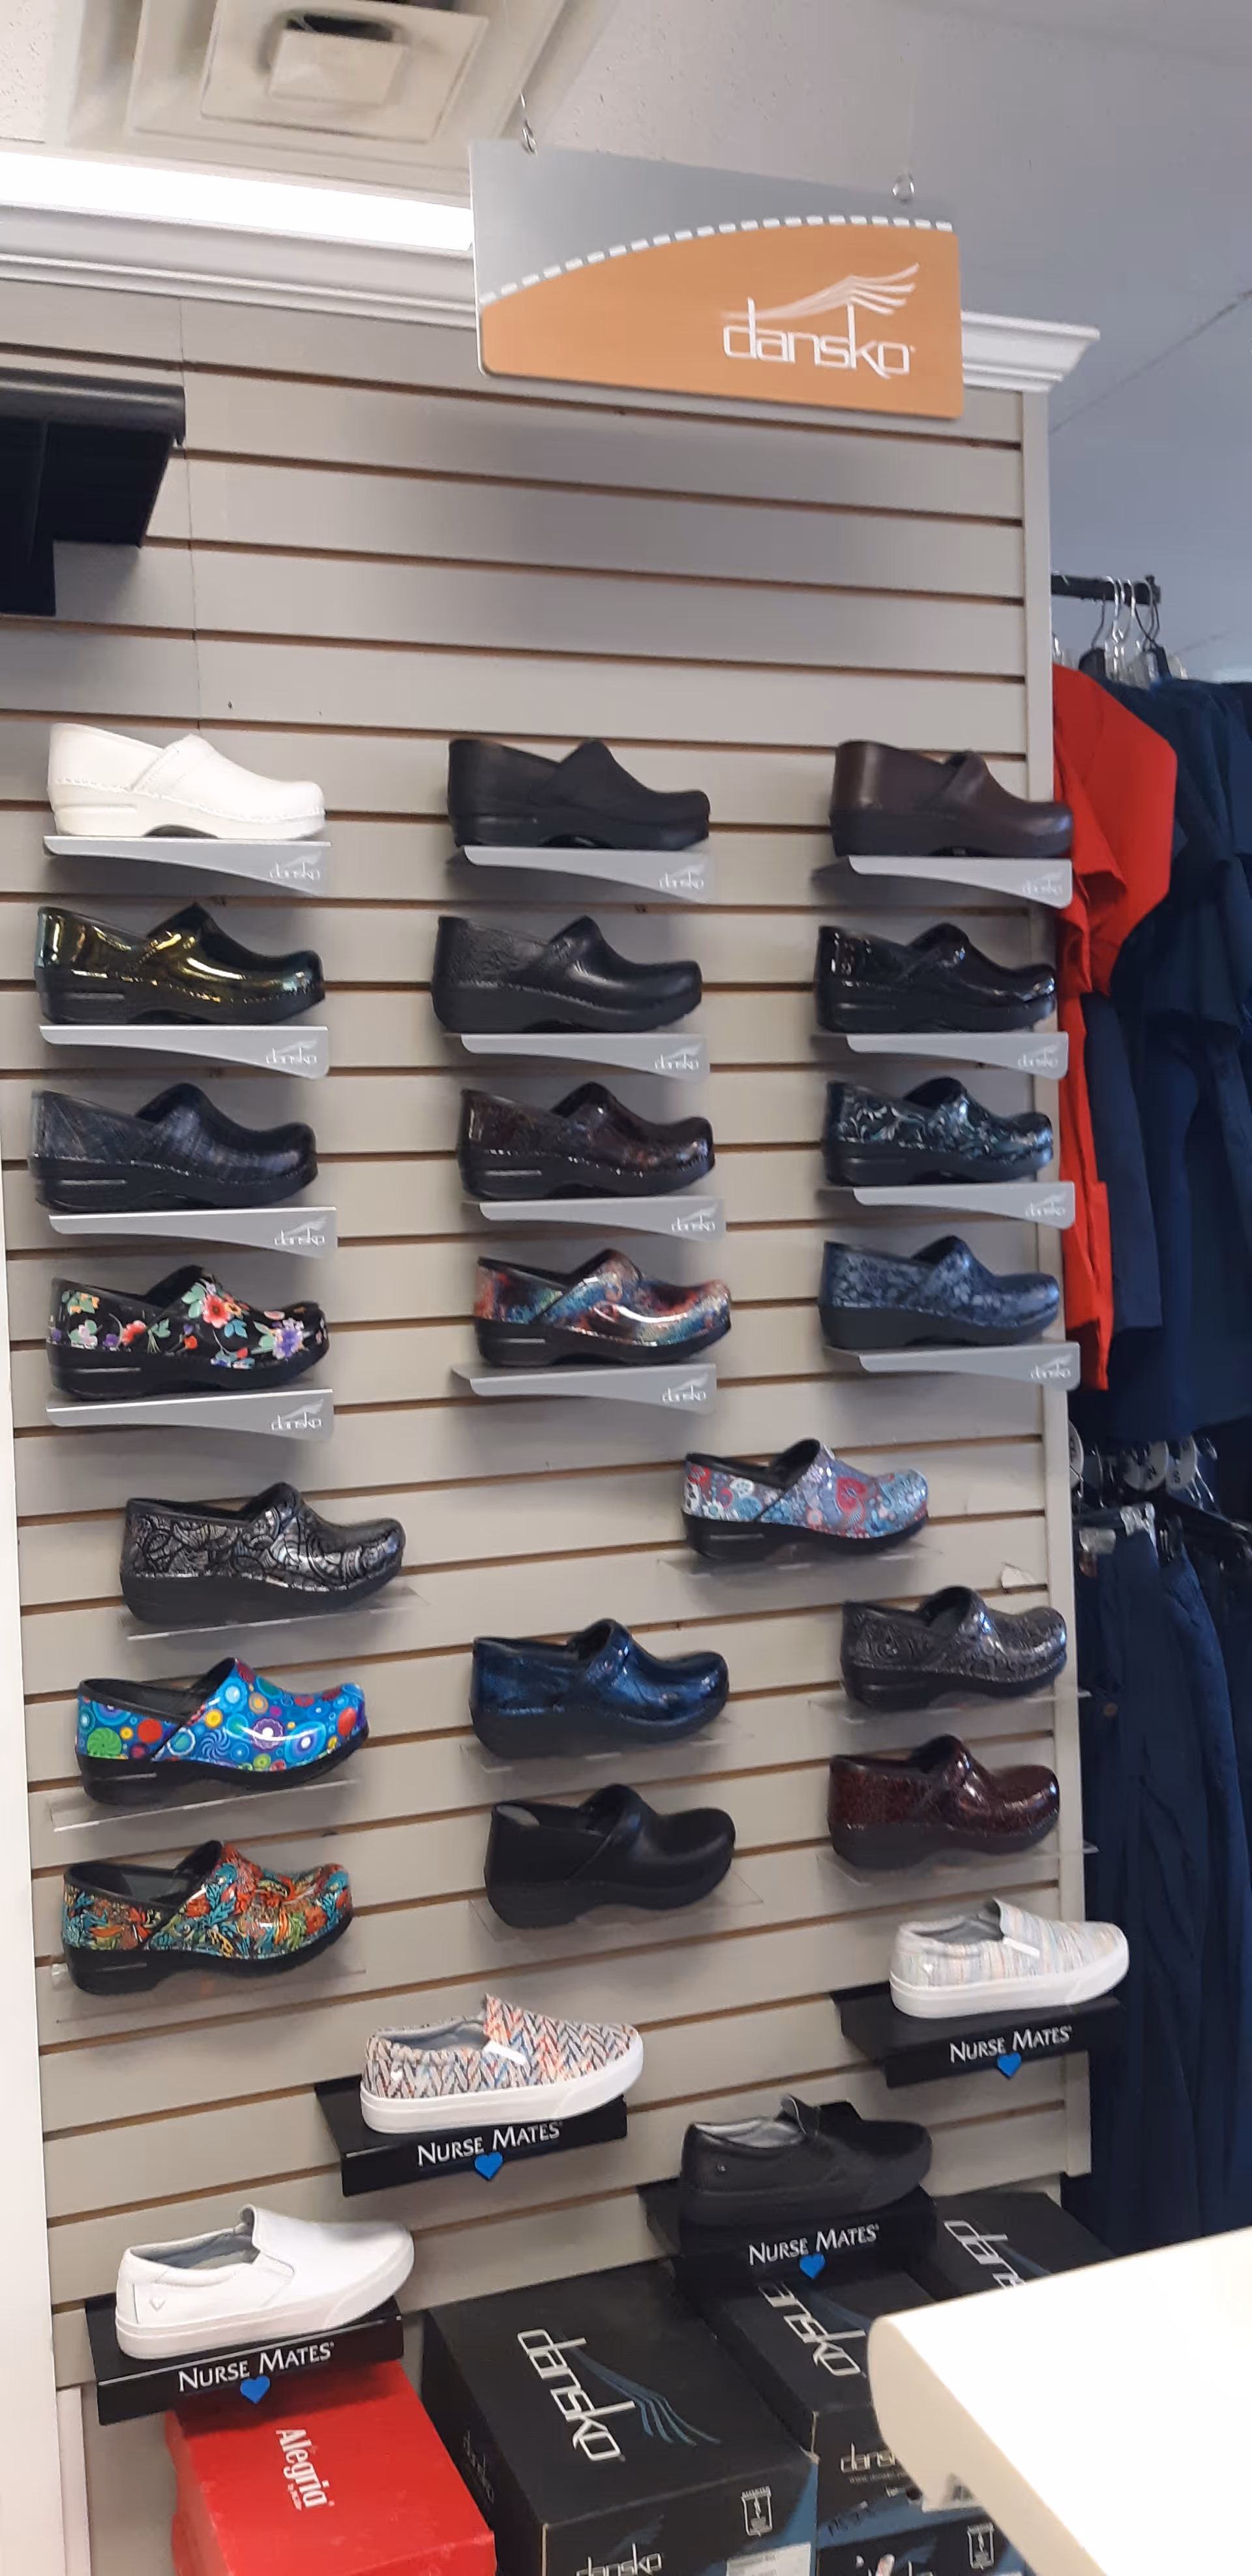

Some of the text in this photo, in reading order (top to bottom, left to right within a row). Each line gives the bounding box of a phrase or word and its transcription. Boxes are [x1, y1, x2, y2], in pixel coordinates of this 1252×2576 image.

[723, 297, 911, 380] dansko
[949, 2027, 1070, 2063] NURSE MATES
[417, 2121, 560, 2167] NURSE MATES
[749, 2224, 877, 2266] NURSE MATES
[758, 2283, 867, 2376] ansko
[177, 2342, 331, 2393] NURSE MATES
[516, 2329, 636, 2461] dansko
[275, 2428, 330, 2509] Alegria
